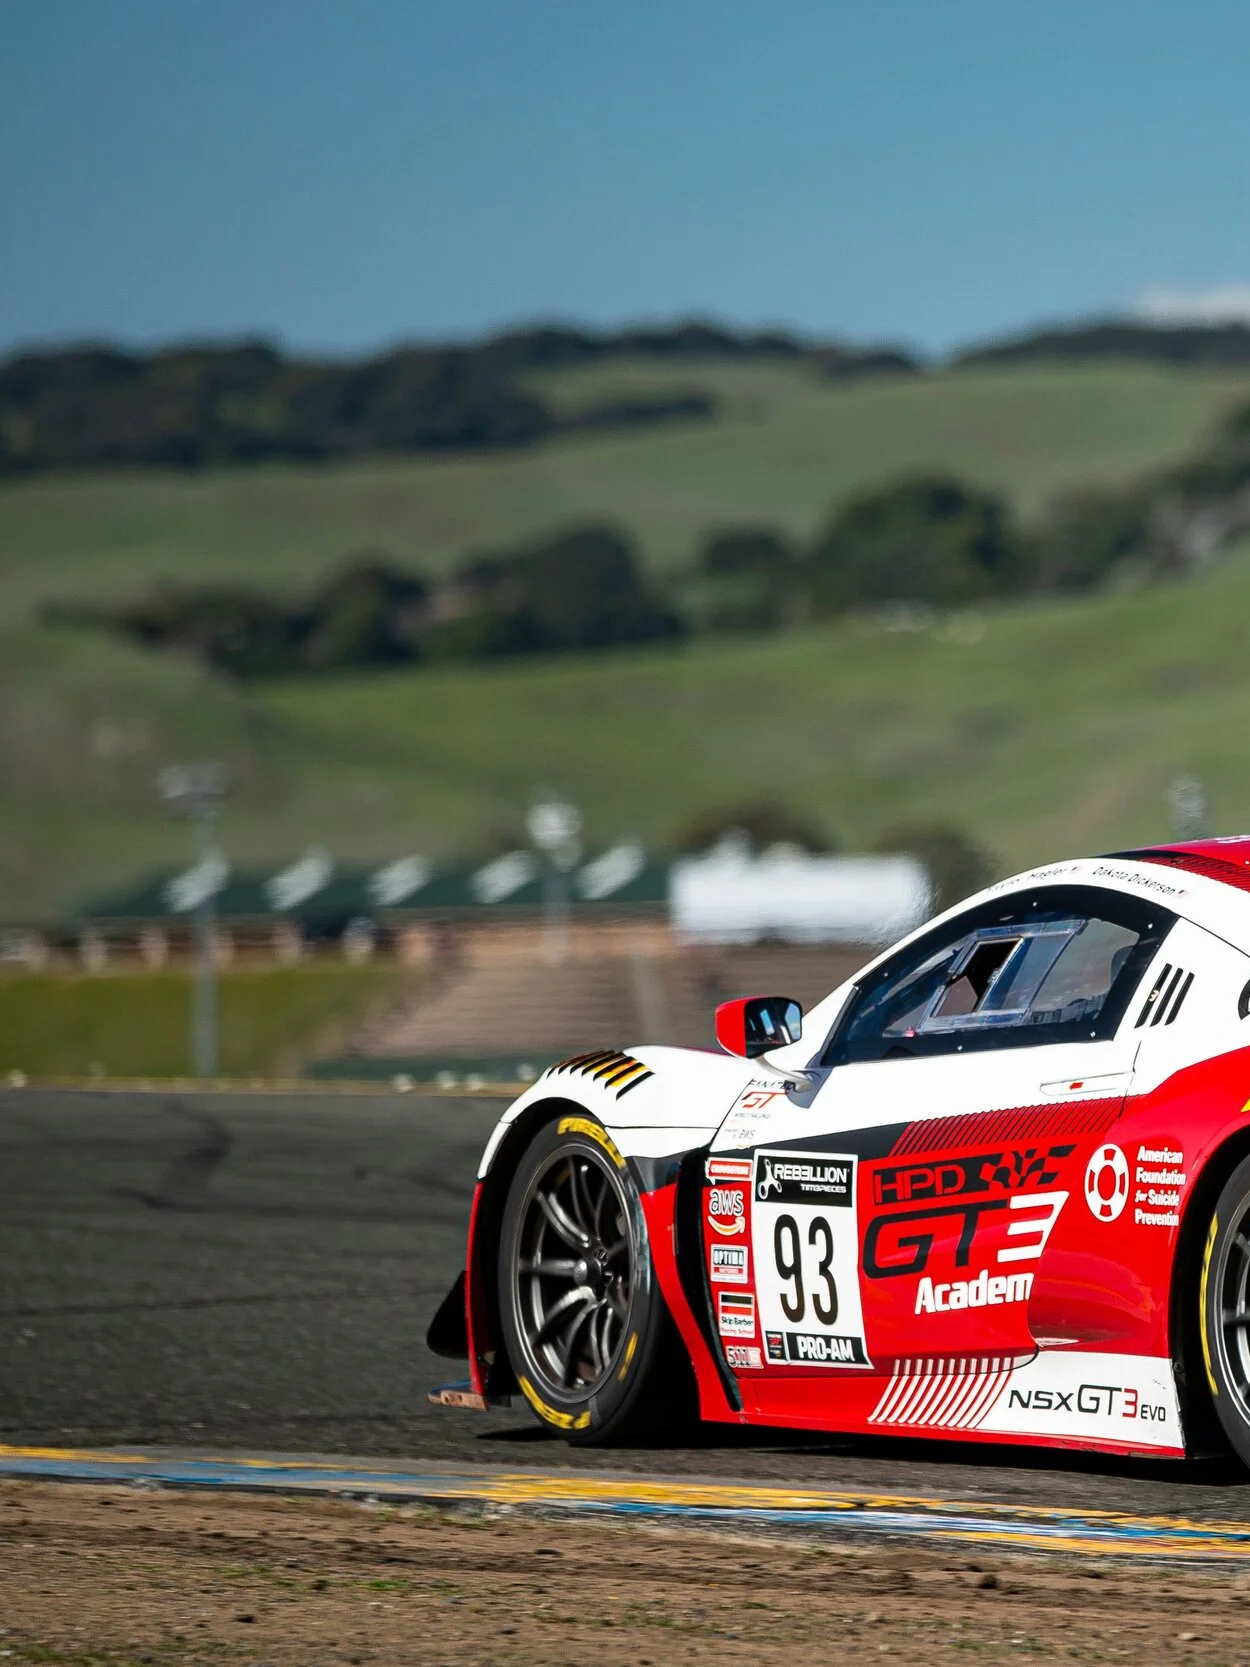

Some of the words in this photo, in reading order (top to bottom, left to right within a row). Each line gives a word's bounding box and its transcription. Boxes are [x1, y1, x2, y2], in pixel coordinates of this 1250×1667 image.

[1092, 866, 1129, 880] Dakota
[1127, 873, 1177, 896] Dickerson
[1136, 1145, 1184, 1164] American
[774, 1163, 847, 1183] REBELLION
[874, 1164, 966, 1204] HPD
[1135, 1166, 1187, 1185] Foundation
[709, 1189, 744, 1217] aws
[1134, 1189, 1148, 1203] for
[1147, 1189, 1180, 1207] Suicide
[862, 1190, 1070, 1280] GT3
[713, 1248, 744, 1267] OPTIMA
[773, 1213, 840, 1326] 93
[914, 1268, 1035, 1315] Academ
[796, 1335, 855, 1361] PRO-AM
